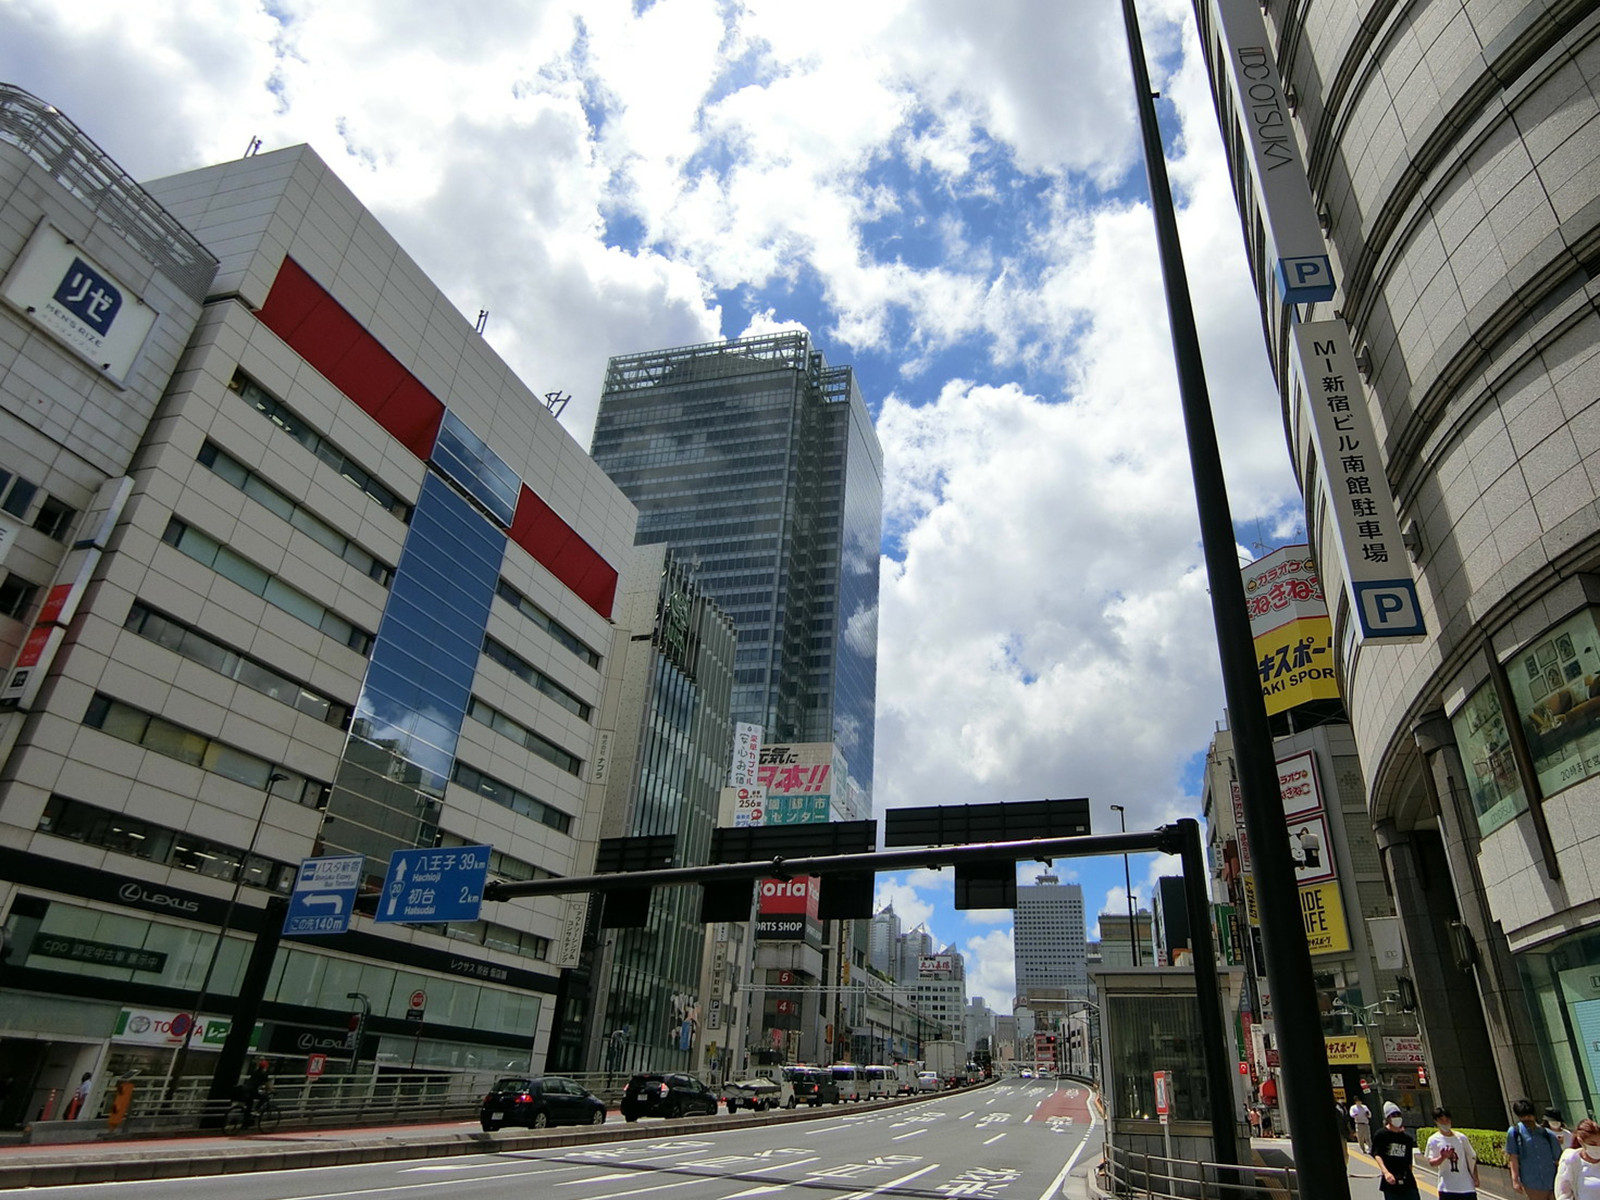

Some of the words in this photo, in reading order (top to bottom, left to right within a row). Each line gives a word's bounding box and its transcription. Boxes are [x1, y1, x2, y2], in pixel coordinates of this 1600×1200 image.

[1295, 262, 1320, 283] P
[66, 272, 114, 323] リゼ
[78, 327, 105, 348] RIZE
[1256, 559, 1301, 588] カラオケ
[1374, 594, 1404, 623] P
[1258, 636, 1332, 682] キスポー
[317, 861, 360, 874] バスタ新宿
[415, 855, 456, 871] 八王子
[412, 873, 442, 883] Hachioji
[392, 884, 402, 894] 20
[408, 888, 436, 905] 初台
[141, 890, 200, 912] LEXUS
[404, 905, 436, 915] Hatsudai
[780, 922, 803, 931] SHOP
[451, 959, 475, 973] レクサス
[781, 973, 789, 982] 5
[779, 1002, 787, 1011] 4
